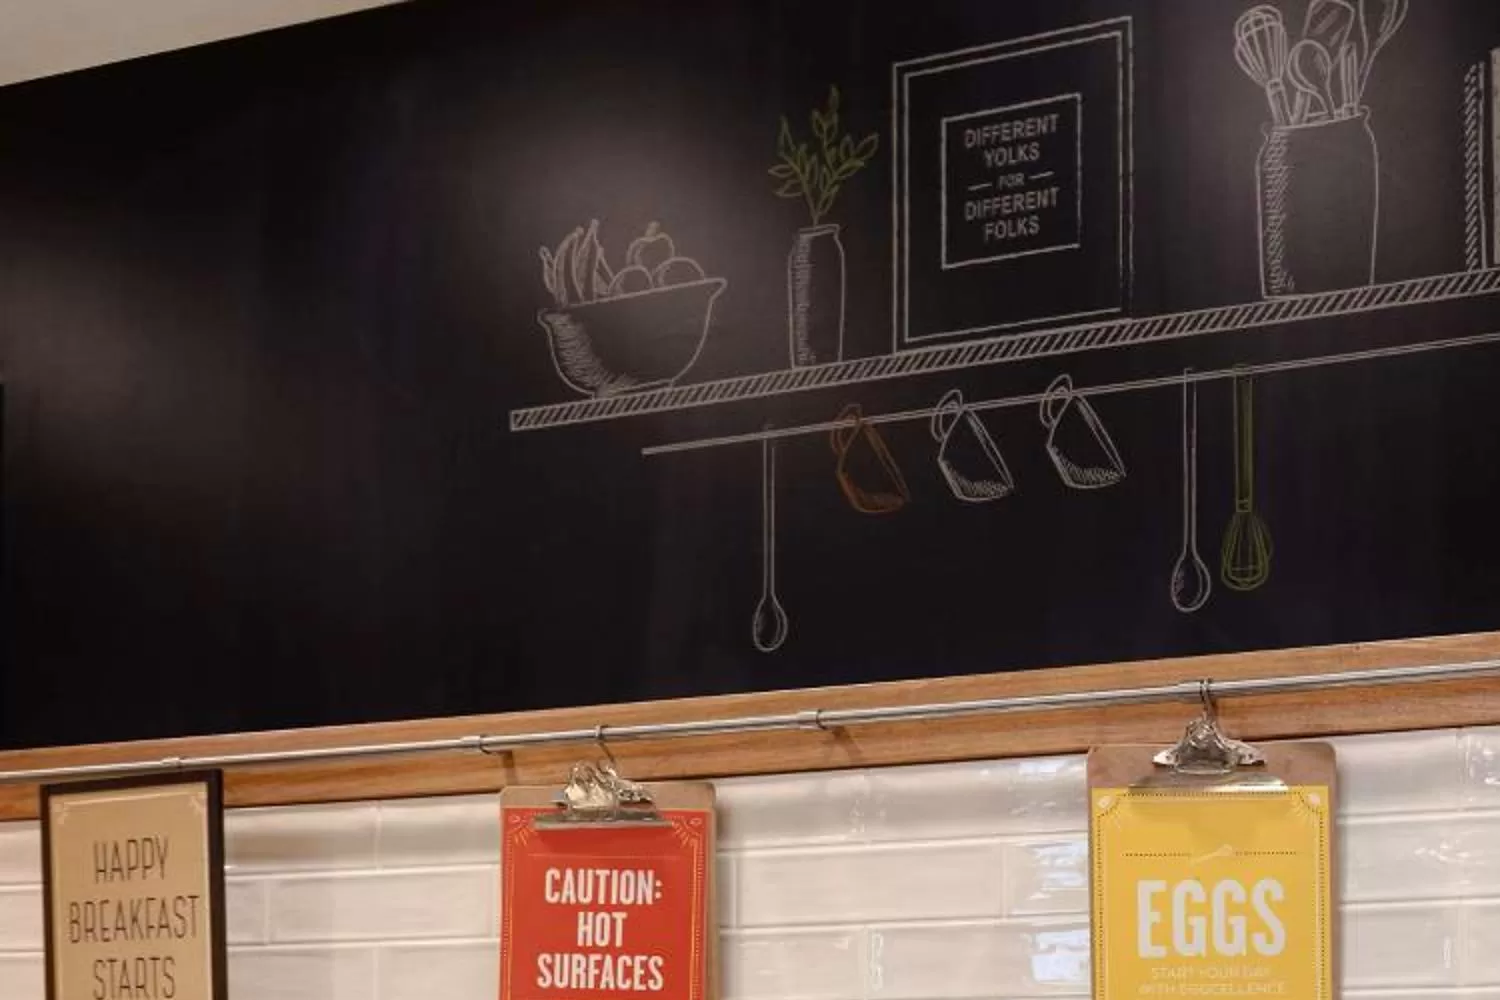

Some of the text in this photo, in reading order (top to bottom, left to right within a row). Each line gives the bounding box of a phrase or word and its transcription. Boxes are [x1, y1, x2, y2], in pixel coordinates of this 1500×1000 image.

[964, 114, 1060, 148] DIFFERENT
[984, 142, 1040, 168] YOLKS
[998, 172, 1025, 188] FOR
[965, 187, 1060, 220] DIFFERENT
[984, 215, 1040, 241] FOLKS
[93, 836, 169, 885] HAPPY
[545, 867, 663, 906] CAUTION:
[68, 894, 200, 945] BREAKFAST
[577, 911, 628, 948] HOT
[1137, 878, 1286, 959] EGGS
[537, 953, 664, 991] SURFACES
